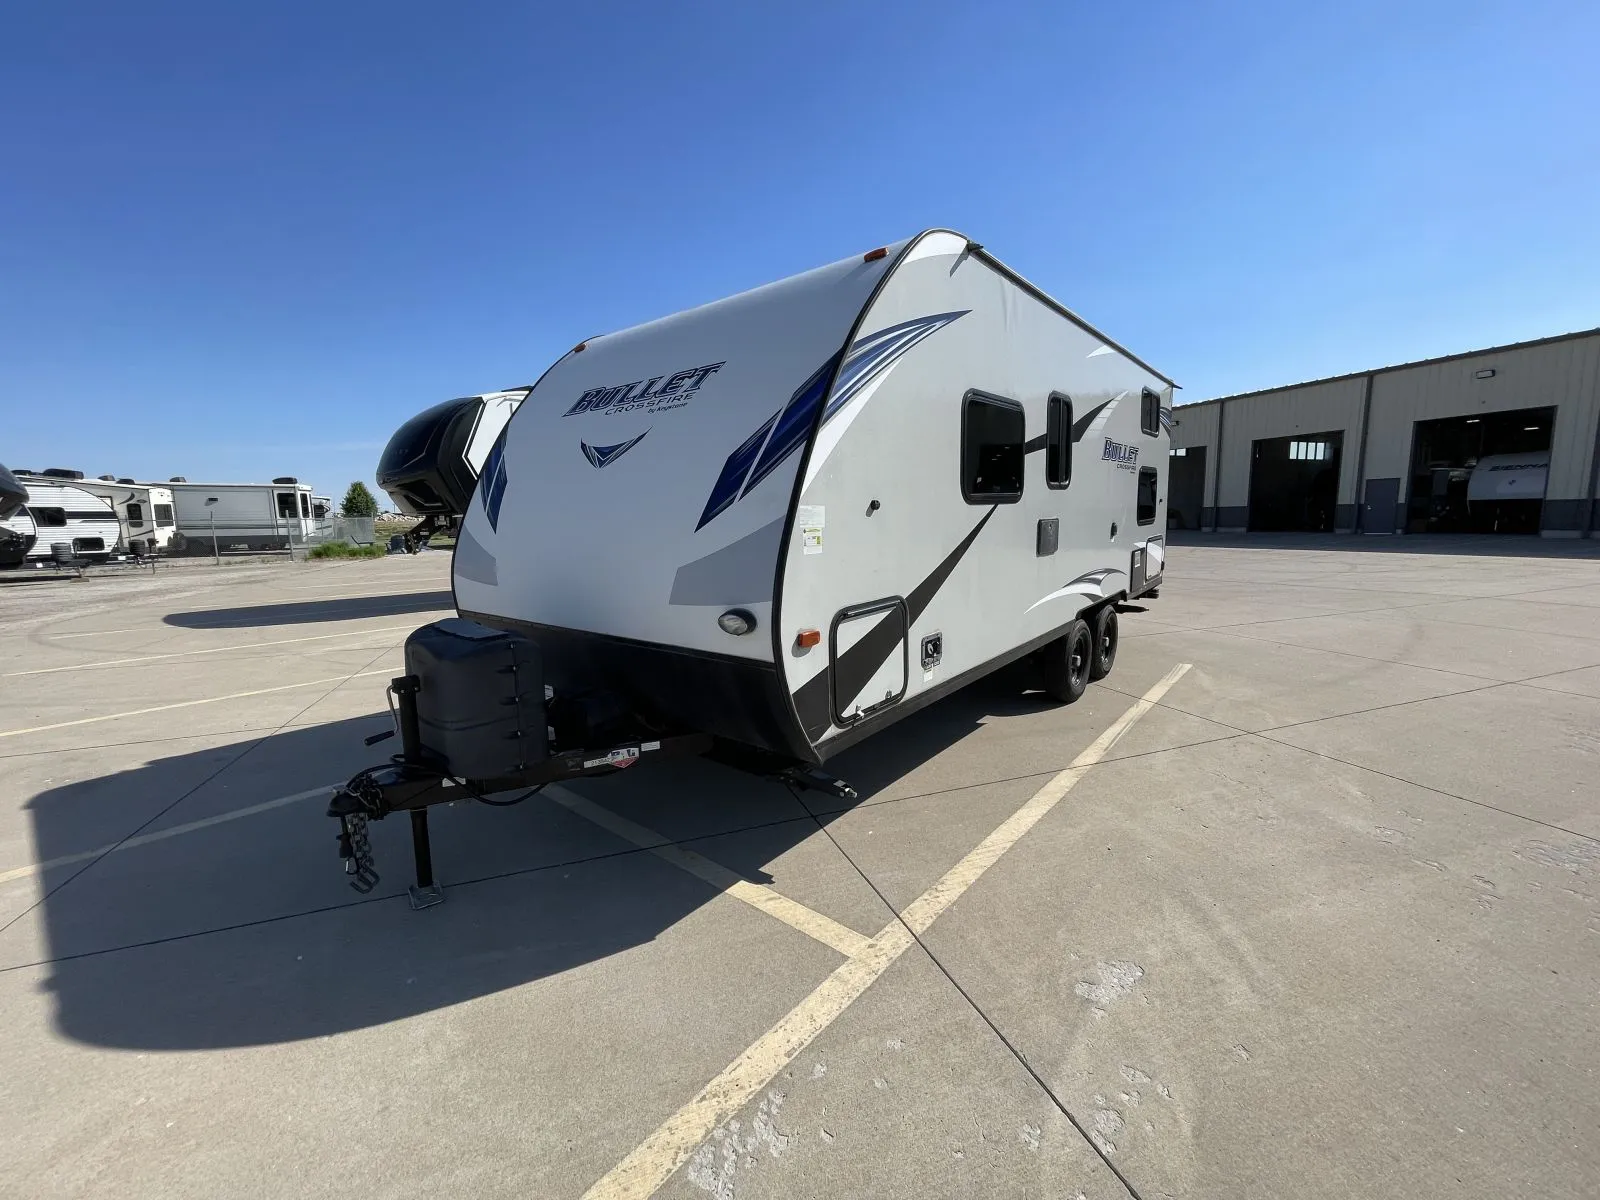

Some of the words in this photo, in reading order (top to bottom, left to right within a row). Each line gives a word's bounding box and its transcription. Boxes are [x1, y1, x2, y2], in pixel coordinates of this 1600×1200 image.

[562, 361, 727, 417] BULLET
[605, 392, 696, 415] CROSSFIRE
[1102, 437, 1139, 464] BULLET
